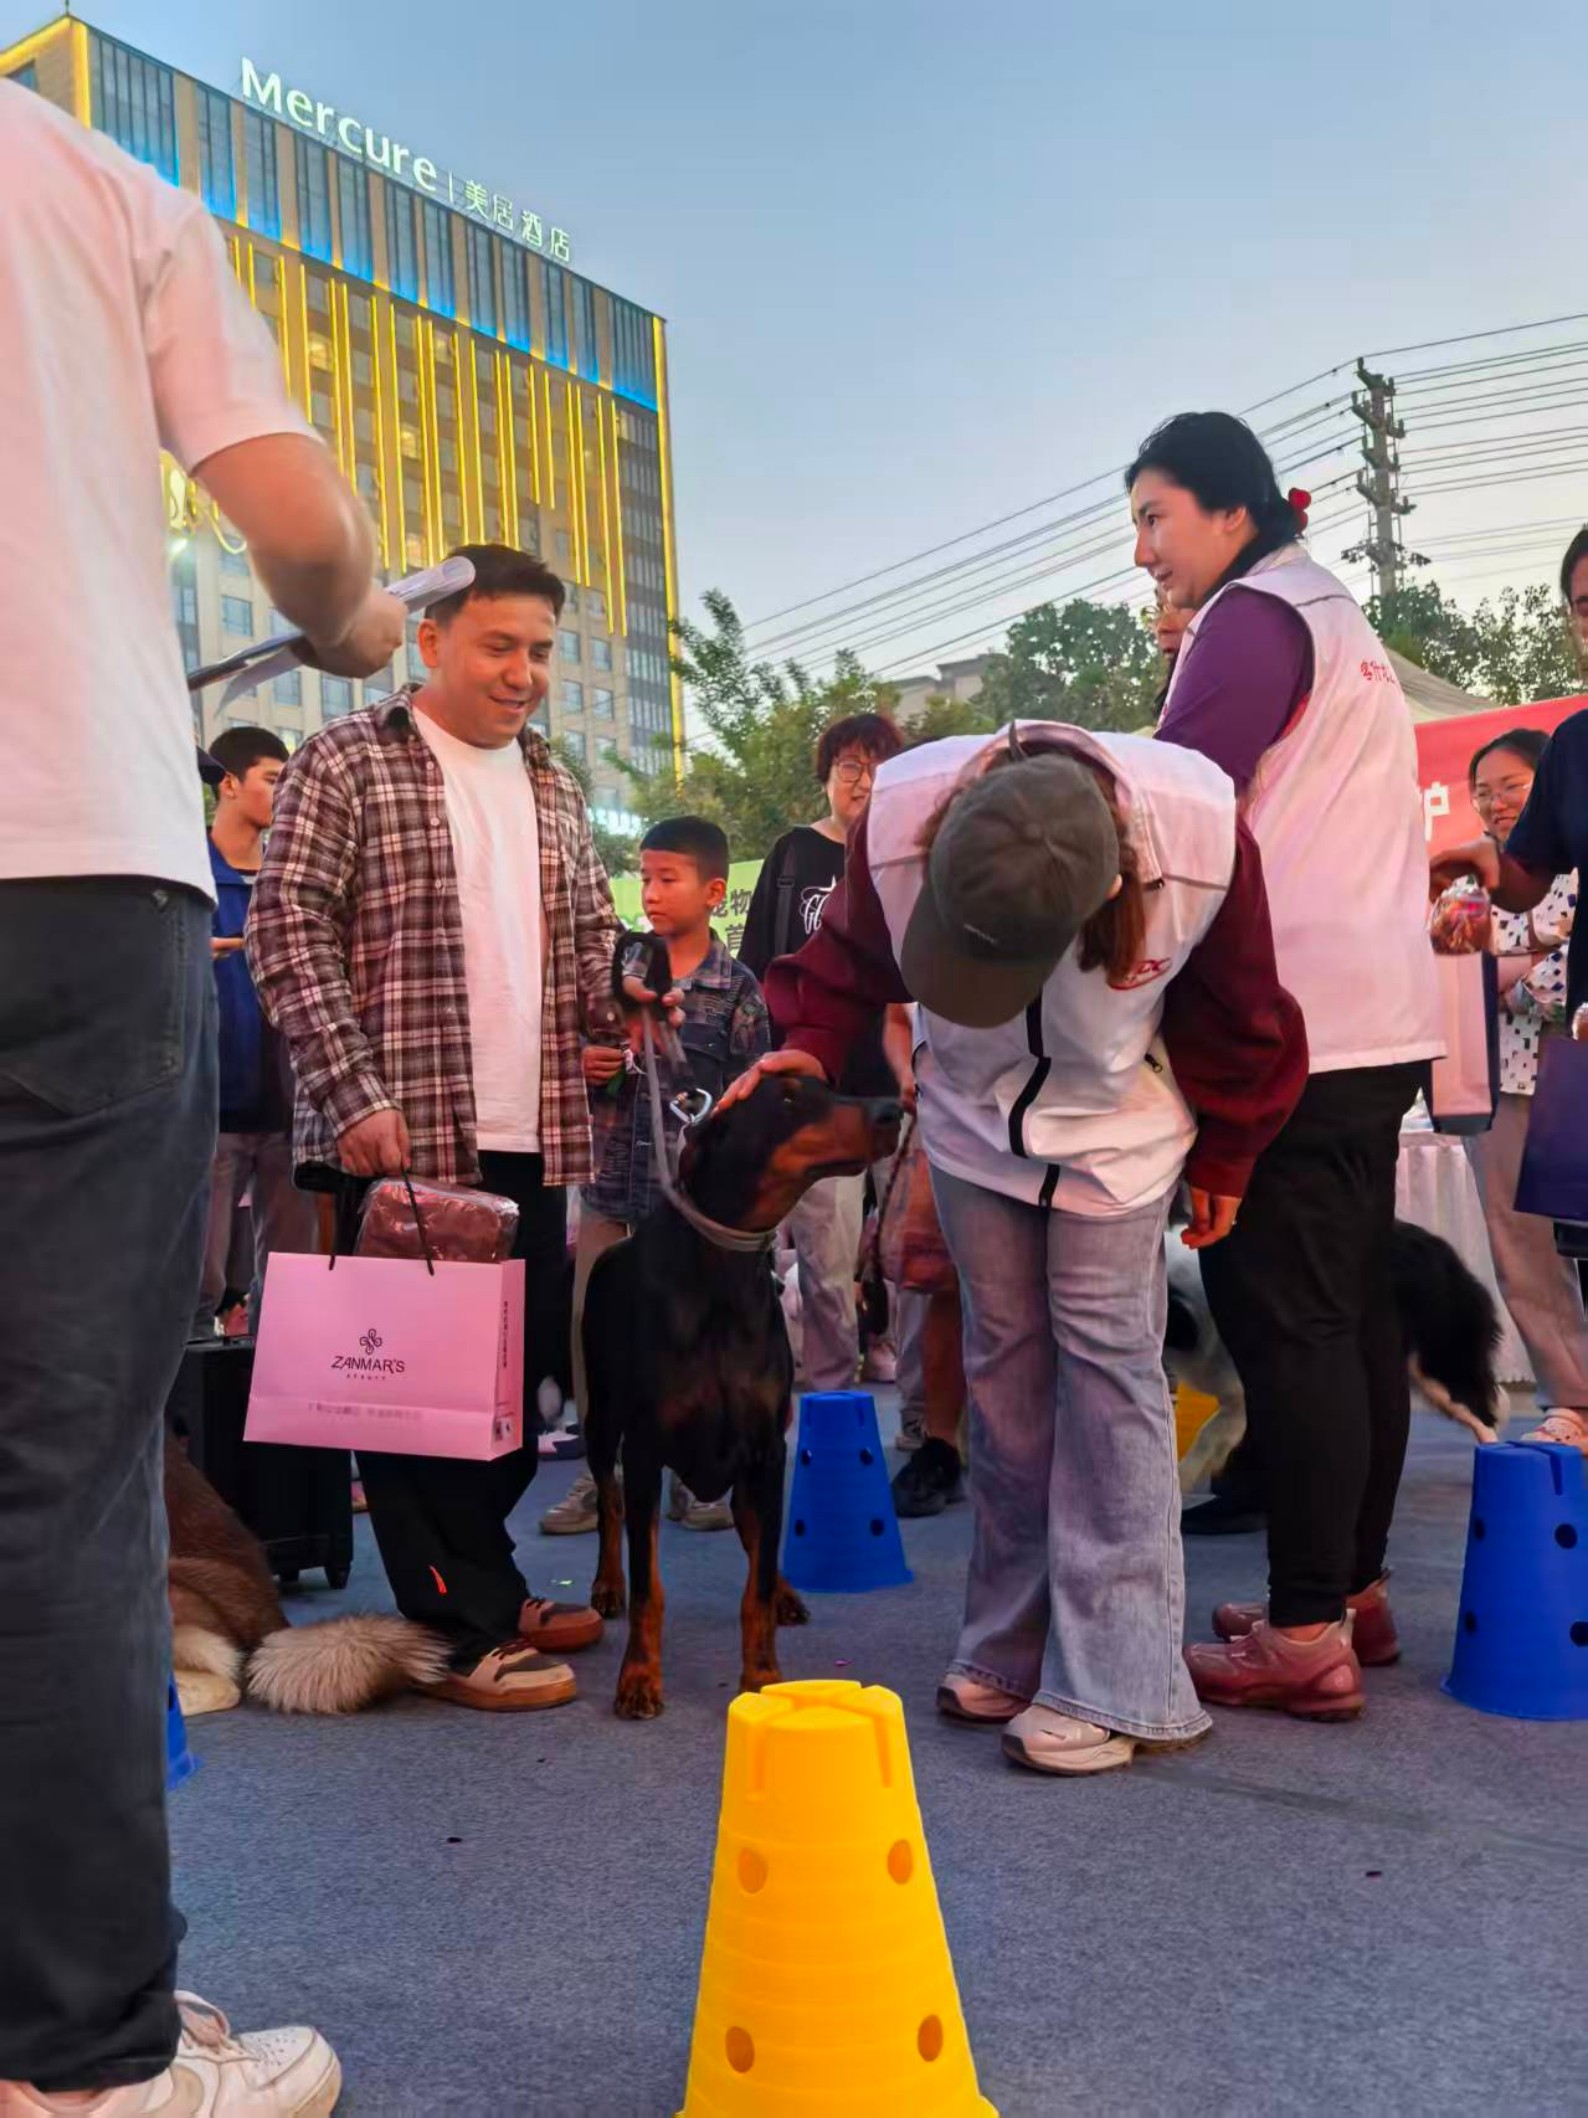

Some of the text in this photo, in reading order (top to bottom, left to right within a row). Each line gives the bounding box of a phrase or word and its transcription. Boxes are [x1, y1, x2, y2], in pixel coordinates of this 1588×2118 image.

[241, 57, 437, 192] Mercure
[464, 180, 570, 262] 美居酒店
[331, 1355, 406, 1374] ZANMAR'S
